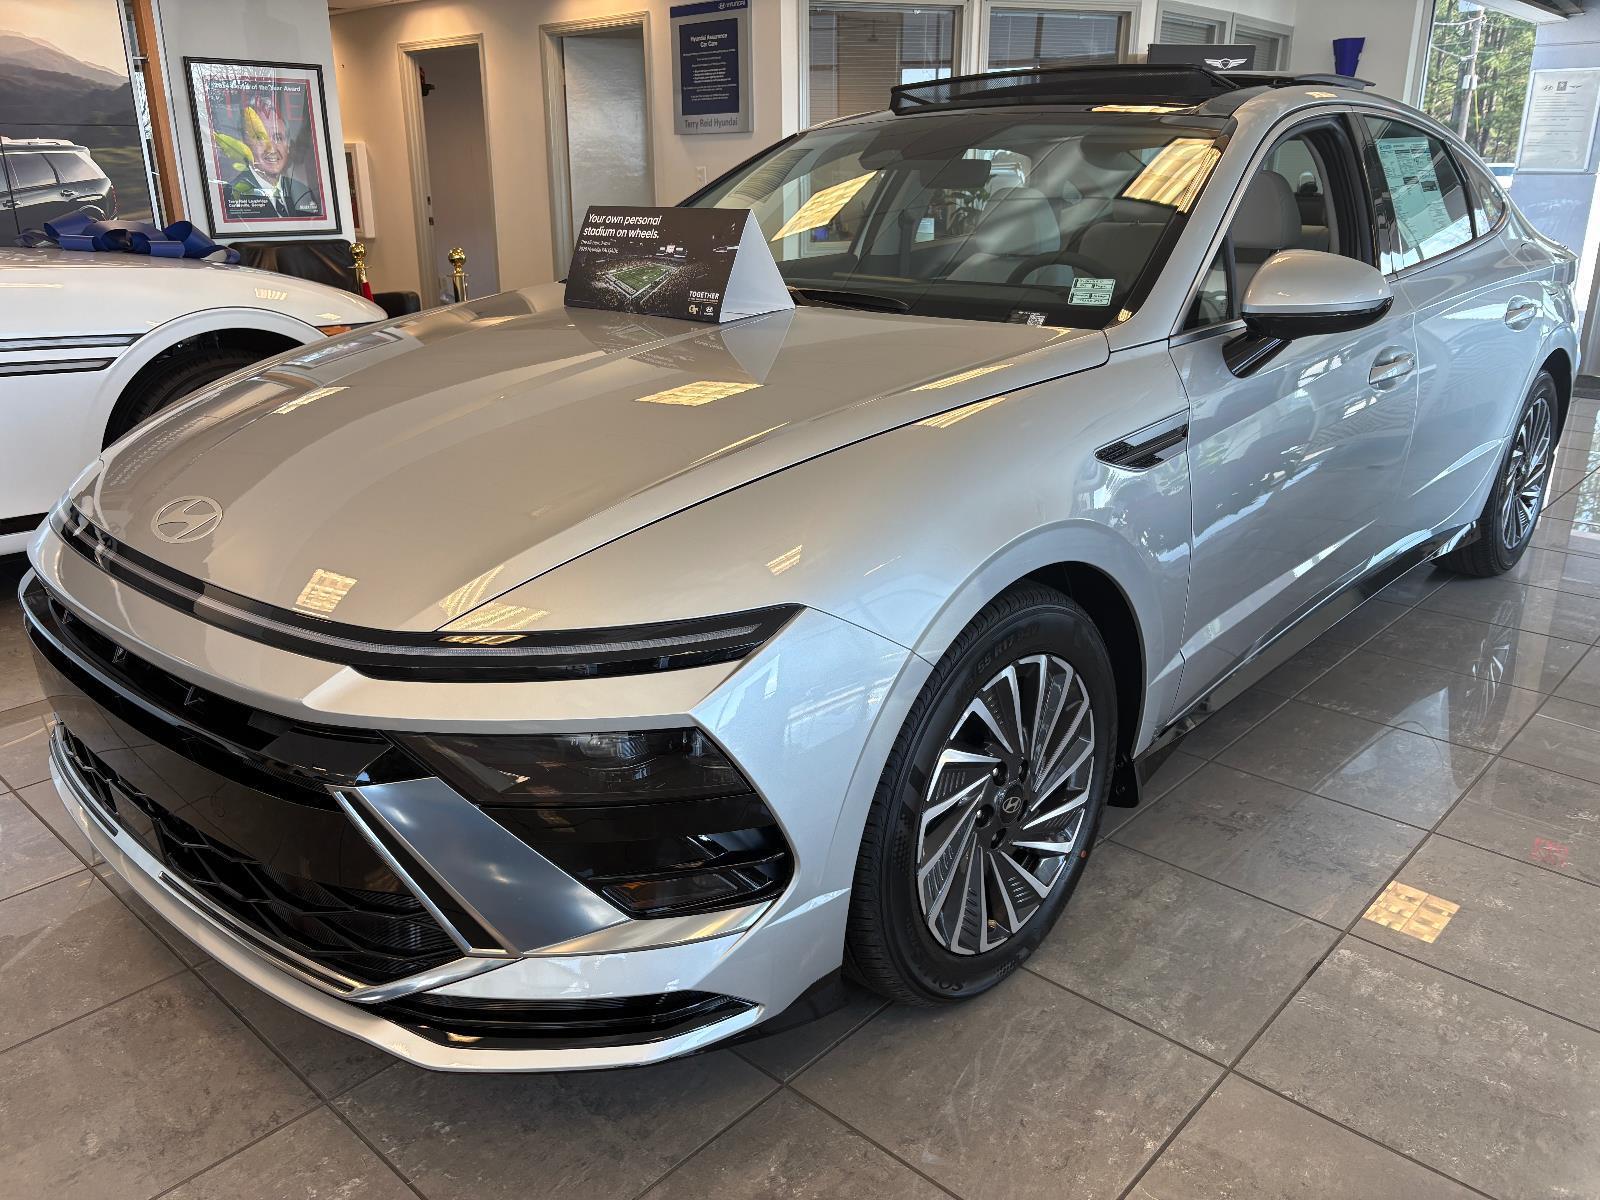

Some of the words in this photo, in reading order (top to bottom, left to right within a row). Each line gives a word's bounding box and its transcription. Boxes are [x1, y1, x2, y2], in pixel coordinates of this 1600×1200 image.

[685, 119, 699, 129] Terry
[700, 118, 713, 127] Reid
[714, 116, 738, 128] Hyundai
[588, 213, 606, 223] Your
[606, 215, 623, 224] own
[624, 215, 663, 226] personal
[583, 226, 616, 237] stadium
[616, 228, 628, 237] on
[628, 228, 660, 239] wheels.
[689, 290, 720, 300] TOGETHER
